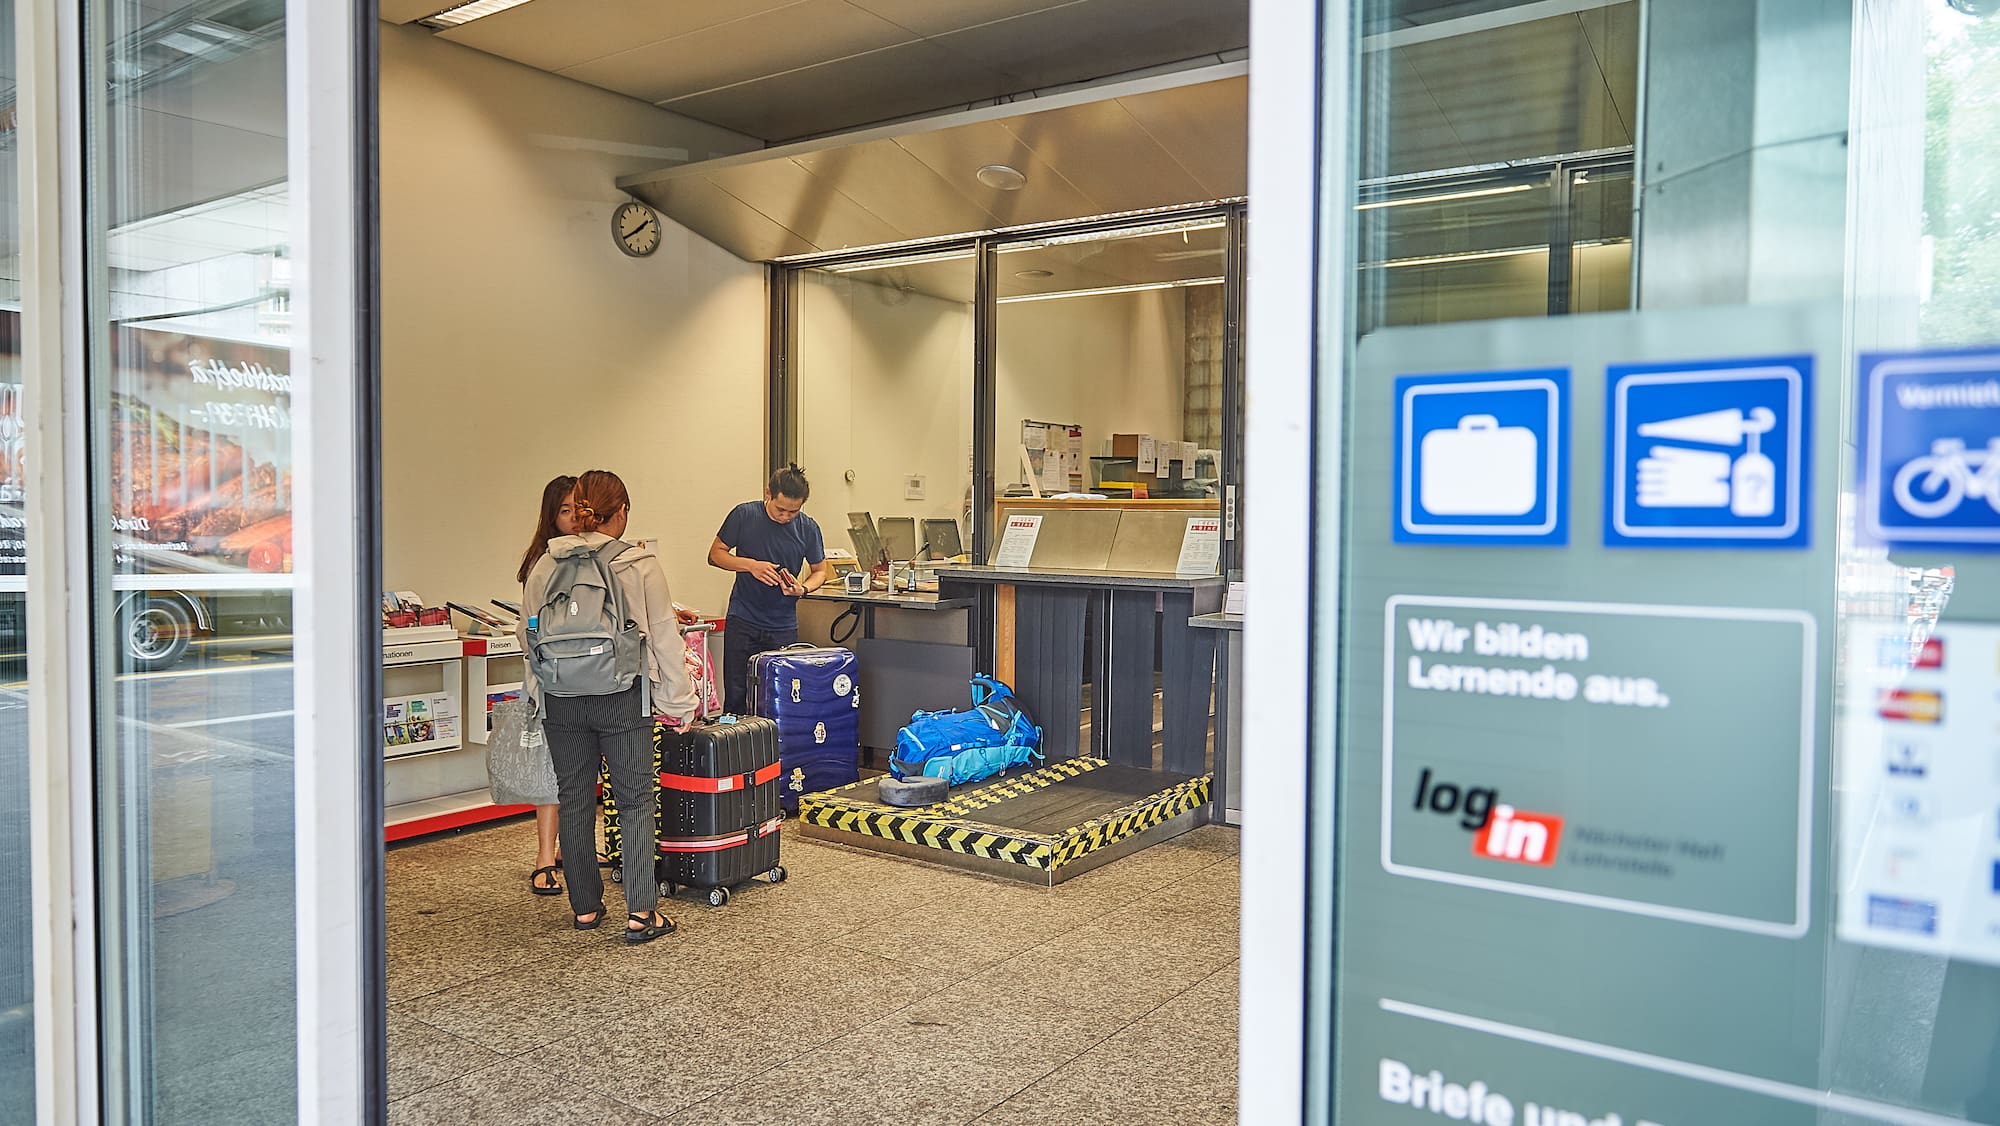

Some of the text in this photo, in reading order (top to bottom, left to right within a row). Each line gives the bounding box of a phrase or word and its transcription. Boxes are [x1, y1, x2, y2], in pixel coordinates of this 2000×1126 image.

[490, 641, 512, 650] Reisen
[1408, 618, 1589, 661] Wir bilden
[1408, 656, 1670, 708] Lernende aus.
[1379, 1058, 1515, 1126] Briefe
